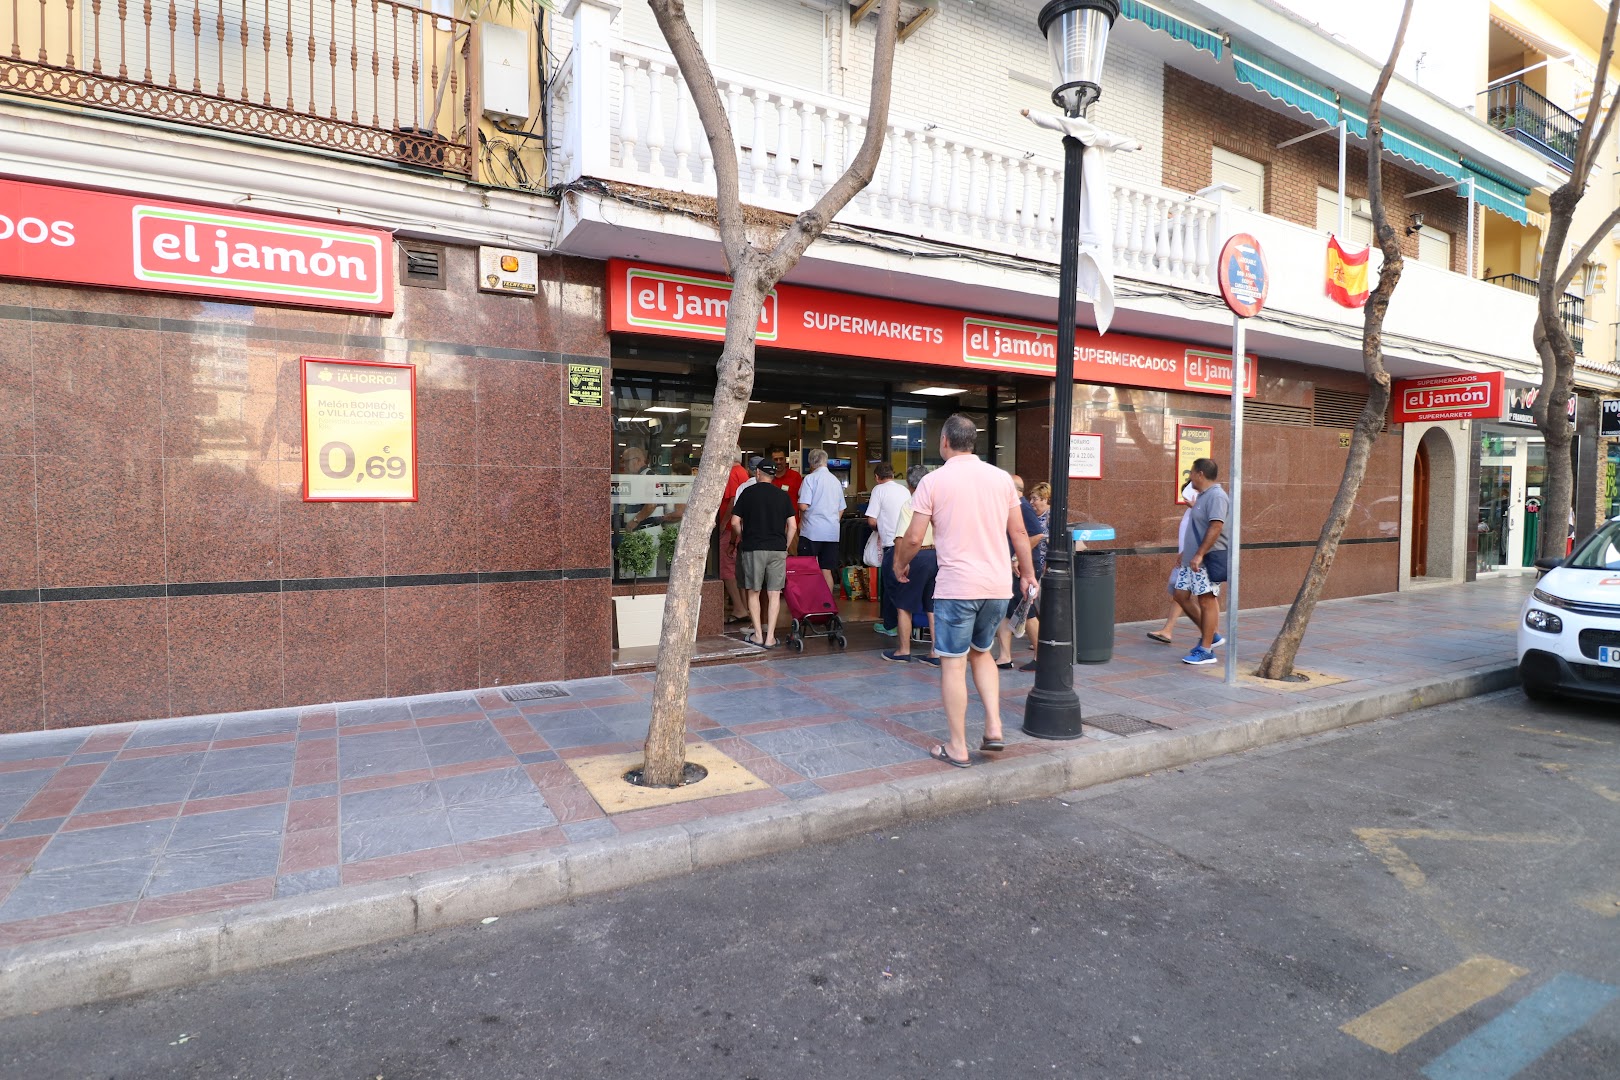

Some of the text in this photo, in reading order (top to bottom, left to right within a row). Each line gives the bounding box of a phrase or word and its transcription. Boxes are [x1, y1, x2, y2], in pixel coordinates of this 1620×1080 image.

[152, 224, 368, 281] el jamón
[638, 282, 667, 311] el
[803, 310, 944, 345] SUPERMARKETS
[970, 326, 1056, 359] el jamón
[1073, 346, 1177, 373] SUPERMERCADOS
[1189, 357, 1203, 376] el
[337, 372, 398, 385] ¡AHORRO!
[1416, 375, 1478, 386] SUPERMERCADOS
[318, 400, 396, 411] Melón BOMBÓN
[1409, 387, 1484, 408] el jamón
[326, 409, 405, 420] VILLACONEJOS
[1418, 411, 1473, 420] SUPERMARKETS
[699, 418, 708, 434] 2
[832, 424, 841, 439] 3
[318, 441, 407, 483] 0,69
